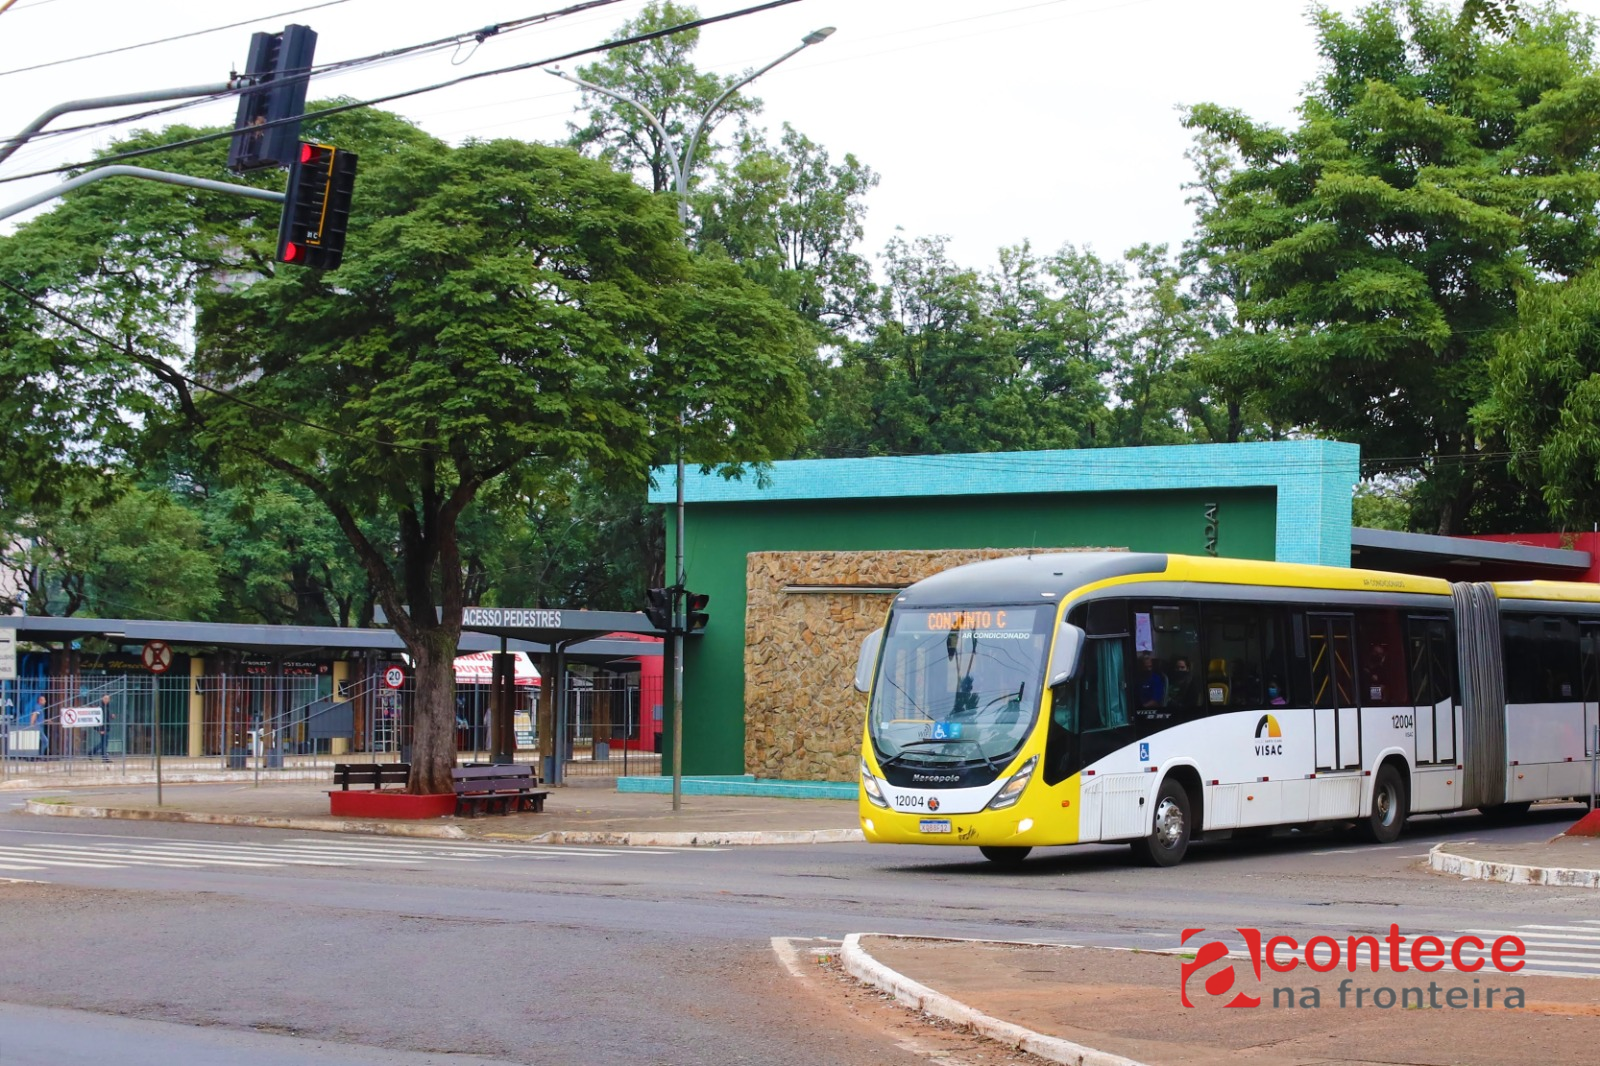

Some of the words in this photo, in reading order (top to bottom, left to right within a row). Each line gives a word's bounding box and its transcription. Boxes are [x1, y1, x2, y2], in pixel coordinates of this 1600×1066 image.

[462, 609, 502, 626] ACESSO
[503, 610, 562, 628] PEDESTRES
[928, 612, 991, 630] CONJUNTO
[997, 611, 1006, 628] C
[973, 632, 1030, 640] CONDICIONADO
[388, 671, 401, 681] 20
[1391, 714, 1413, 729] 12004
[1255, 744, 1283, 757] VISAC
[912, 773, 960, 783] Marcopolo
[895, 795, 924, 808] 12004
